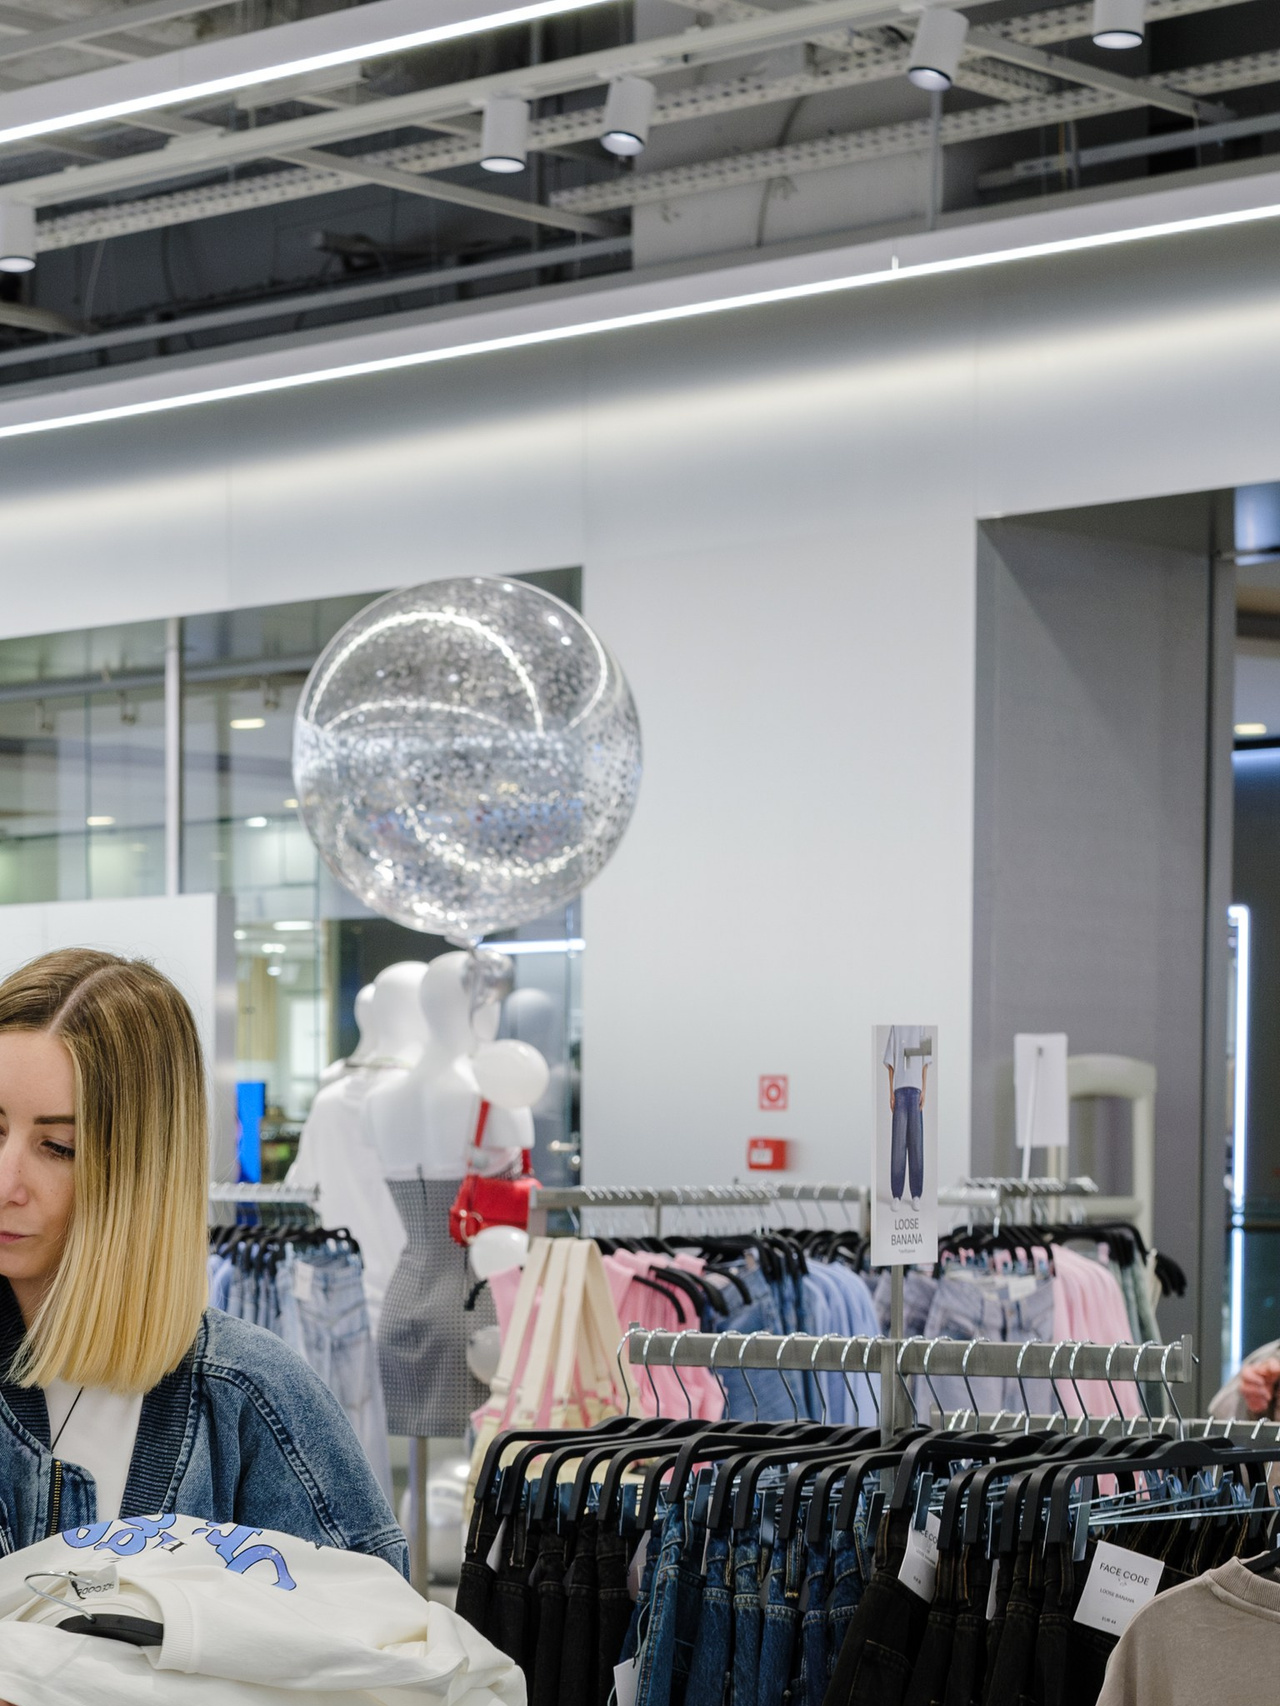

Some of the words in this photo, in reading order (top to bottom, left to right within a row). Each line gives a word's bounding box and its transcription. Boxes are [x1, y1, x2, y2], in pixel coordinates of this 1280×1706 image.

[894, 1218, 919, 1230] LOOSE
[890, 1233, 923, 1246] BANANA
[1100, 1562, 1122, 1577] FACE
[1122, 1570, 1150, 1586] CODE
